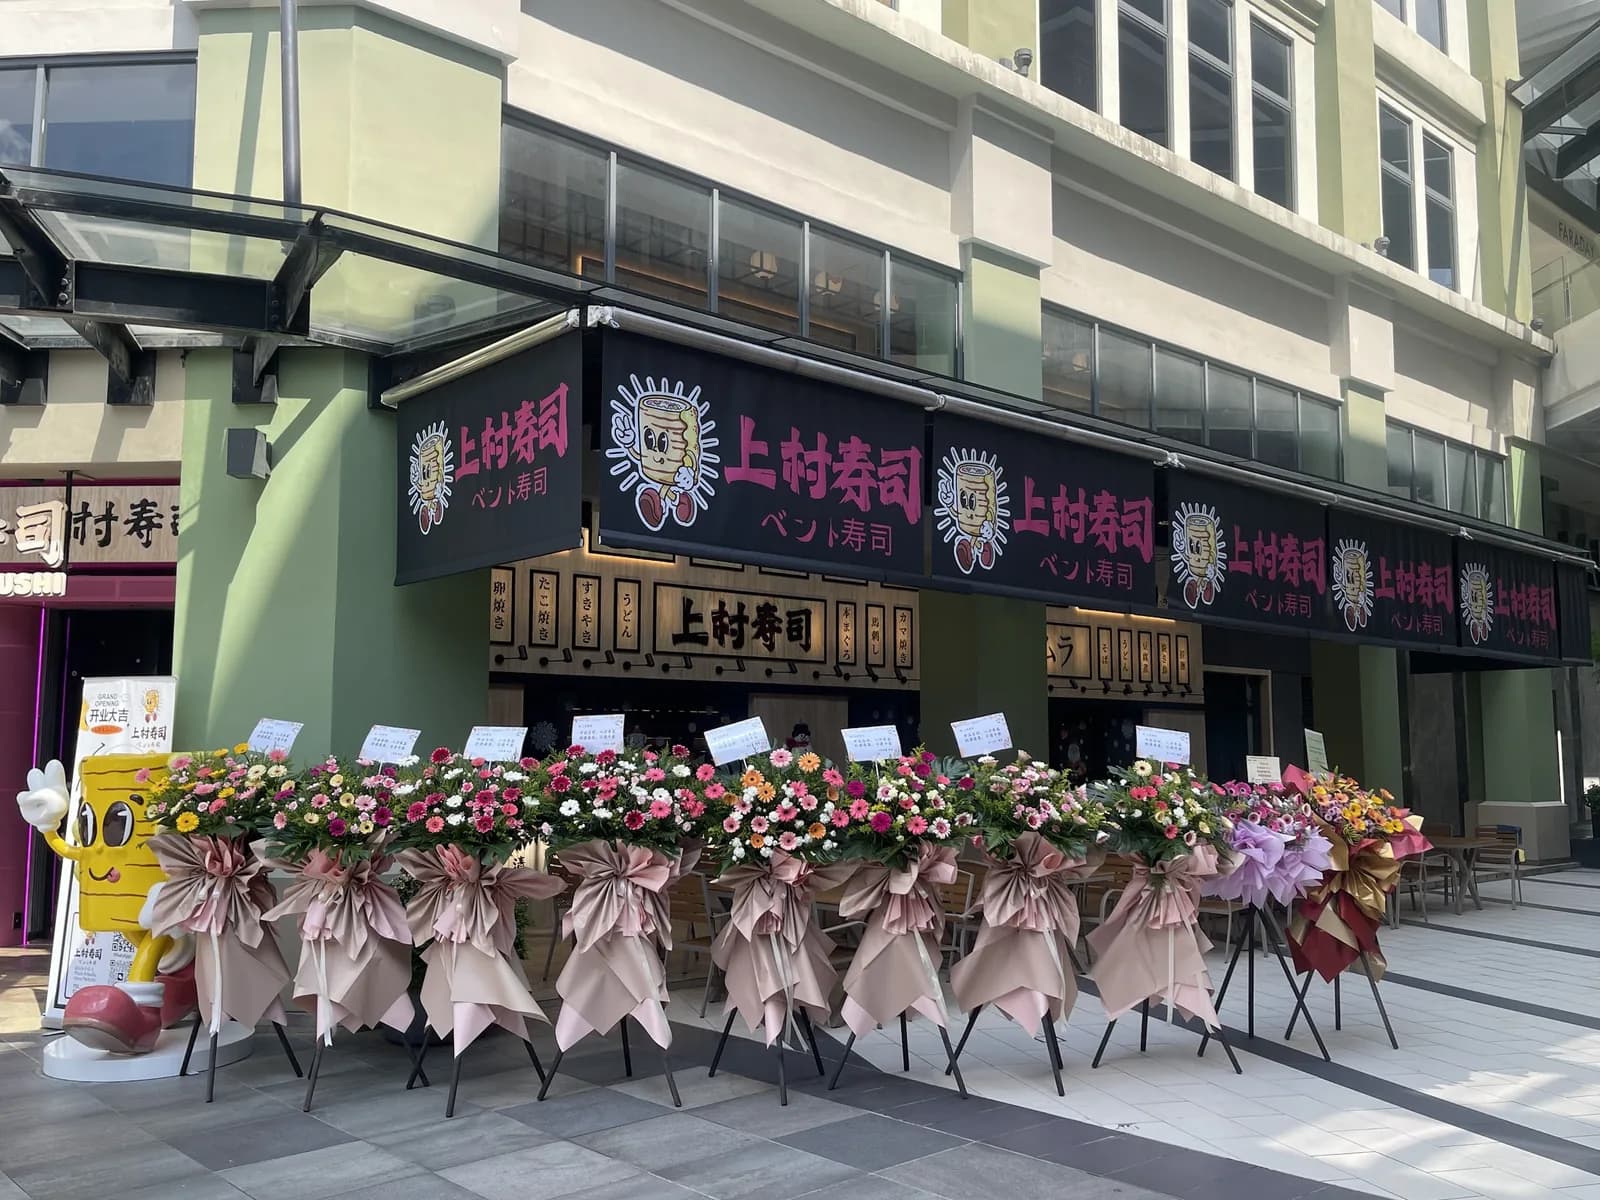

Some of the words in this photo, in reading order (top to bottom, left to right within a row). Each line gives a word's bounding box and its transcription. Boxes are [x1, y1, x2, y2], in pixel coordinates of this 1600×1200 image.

[455, 382, 569, 482] 上村寿司
[472, 466, 548, 509] ベント寿司
[724, 414, 923, 526] 上村寿司
[0, 500, 68, 568] 司
[761, 509, 893, 556] ベント寿司
[1013, 475, 1154, 564] 上村寿司
[1039, 553, 1134, 590] ベント寿司
[1229, 523, 1326, 595] 上村寿司
[1375, 556, 1454, 616] 上村寿司
[538, 576, 550, 641] たこ焼き
[581, 581, 593, 643] すきやき
[621, 593, 632, 638] うどん
[672, 595, 812, 653] 上村寿司
[1494, 577, 1556, 631] 上村寿司
[90, 708, 129, 722] 开业大吉
[131, 726, 167, 741] 上村寿司
